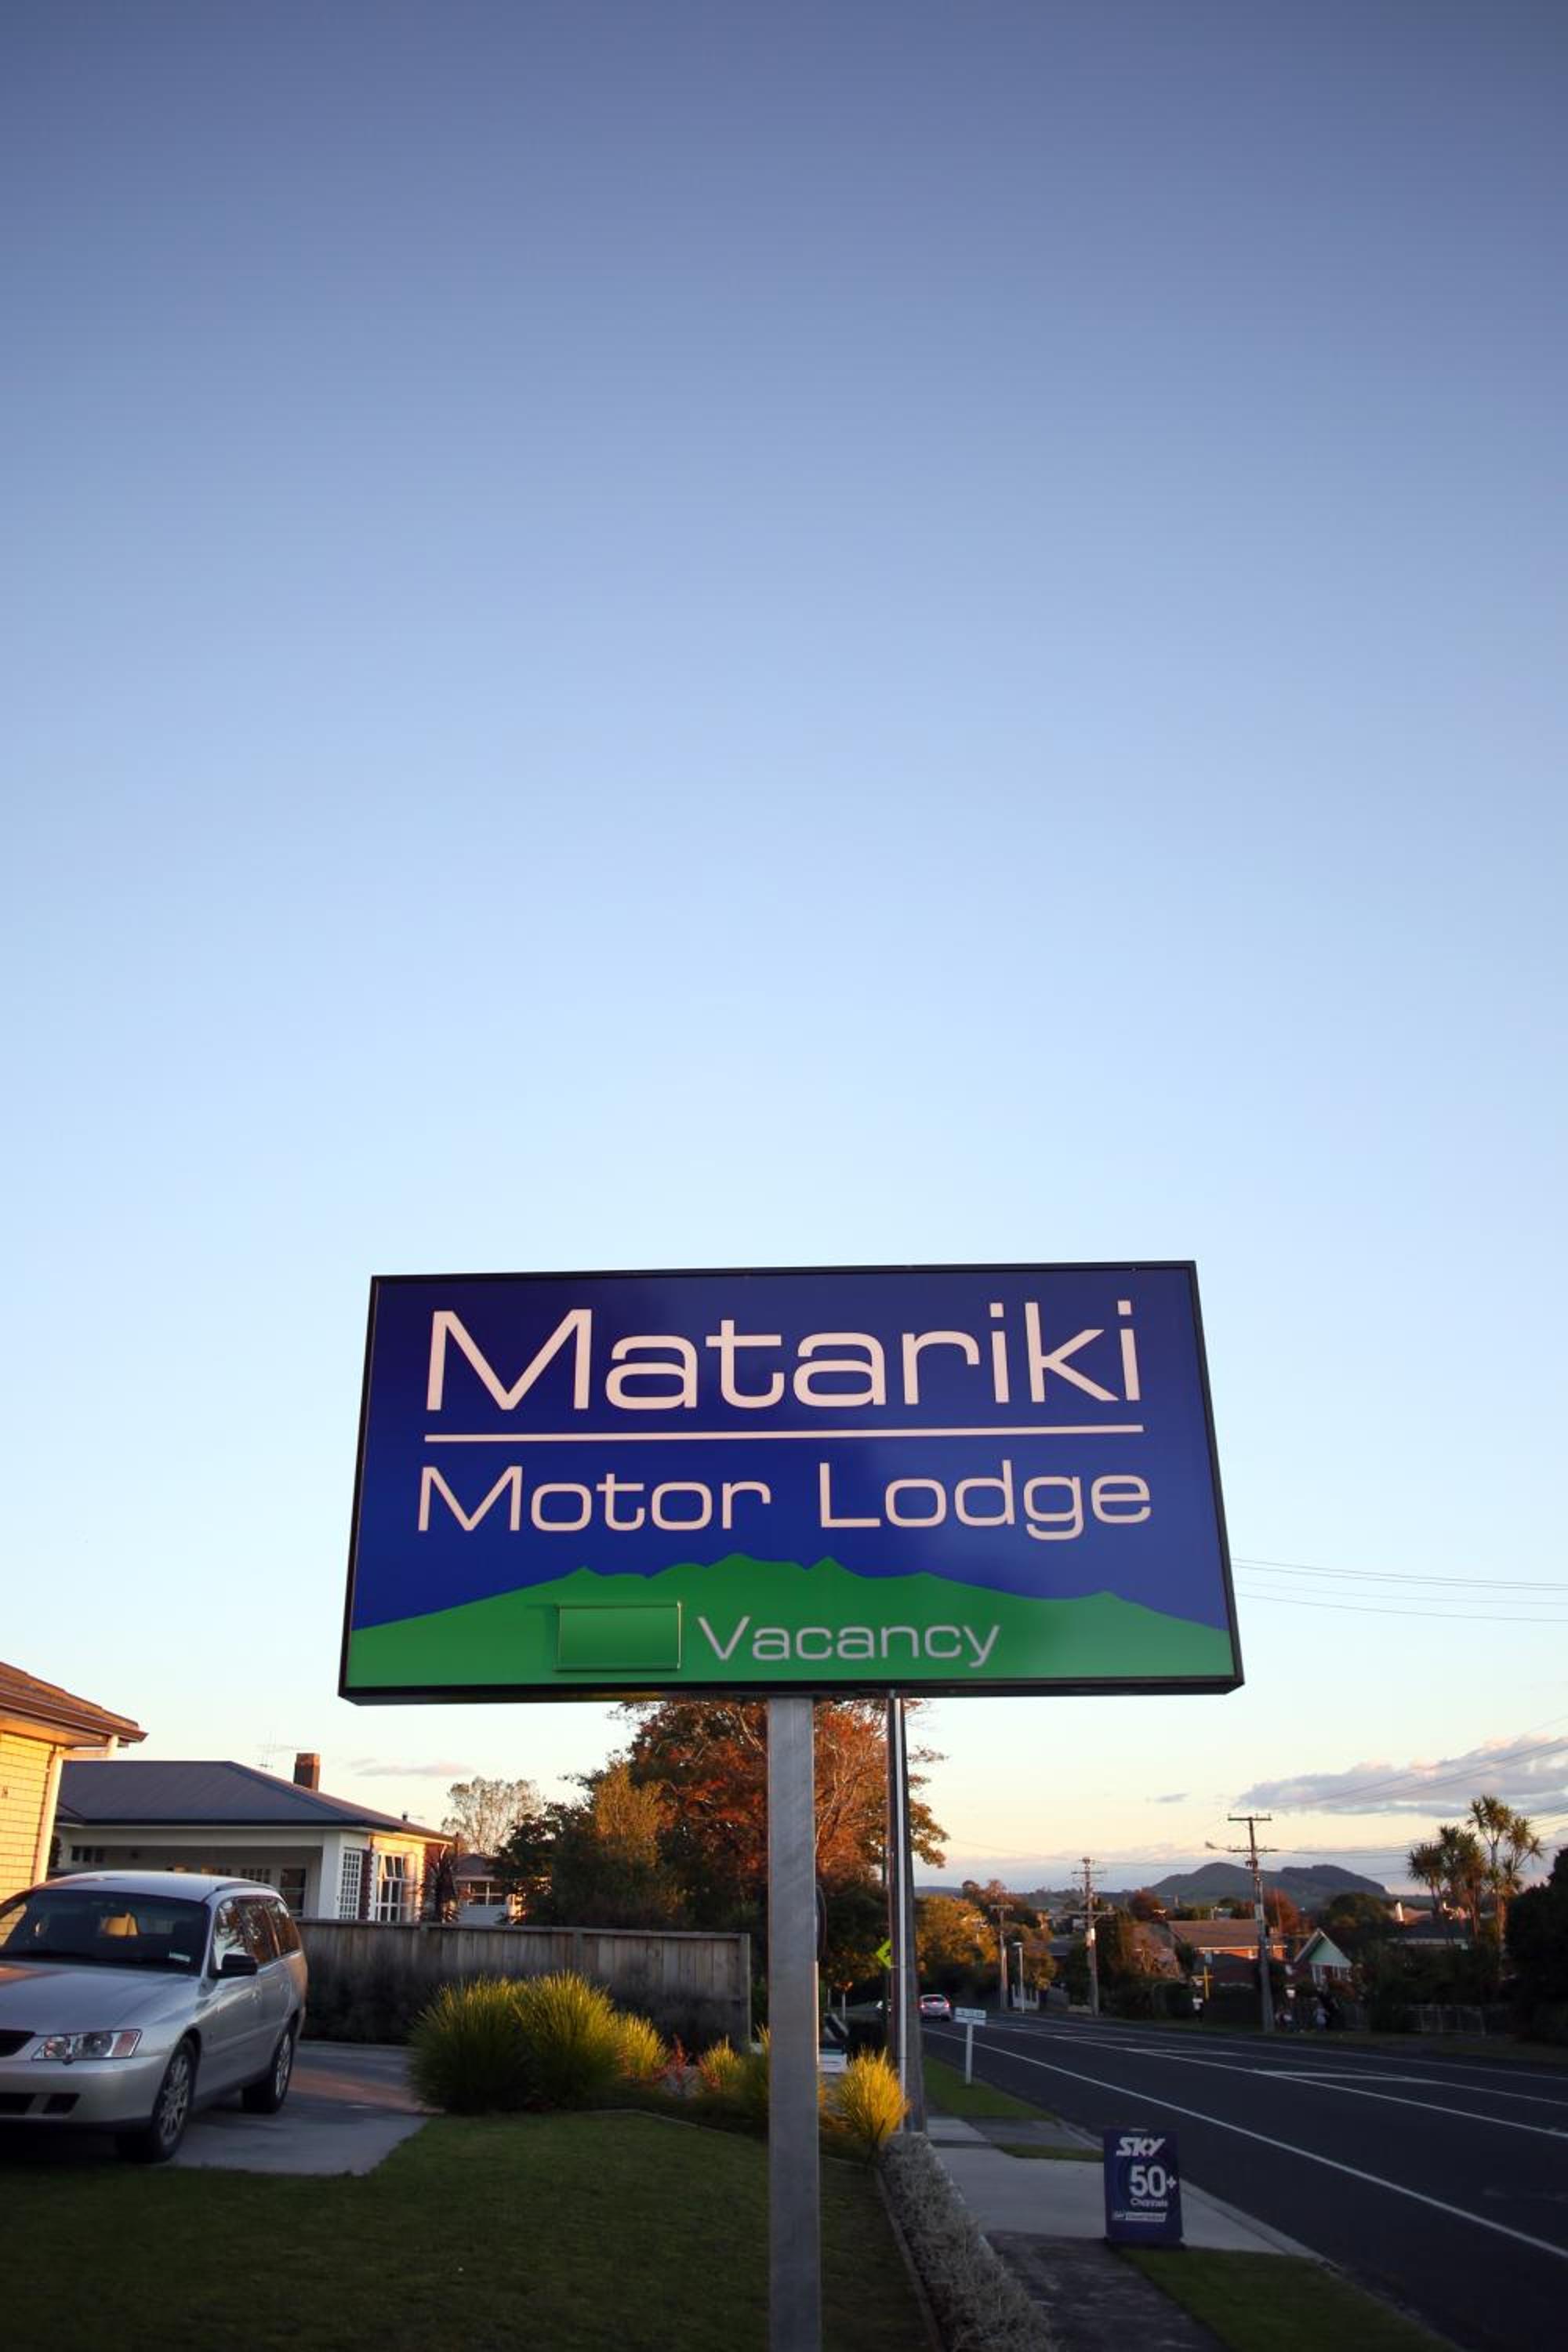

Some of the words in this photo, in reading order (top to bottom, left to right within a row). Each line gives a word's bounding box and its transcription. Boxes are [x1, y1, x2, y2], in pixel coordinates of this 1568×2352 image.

[426, 1300, 1141, 1410] Matariki
[417, 1465, 771, 1532] Motor
[819, 1459, 1151, 1541] Lodge
[697, 1615, 1000, 1668] Vacancy
[1116, 2136, 1166, 2157] SKY
[1129, 2165, 1177, 2198] 50+
